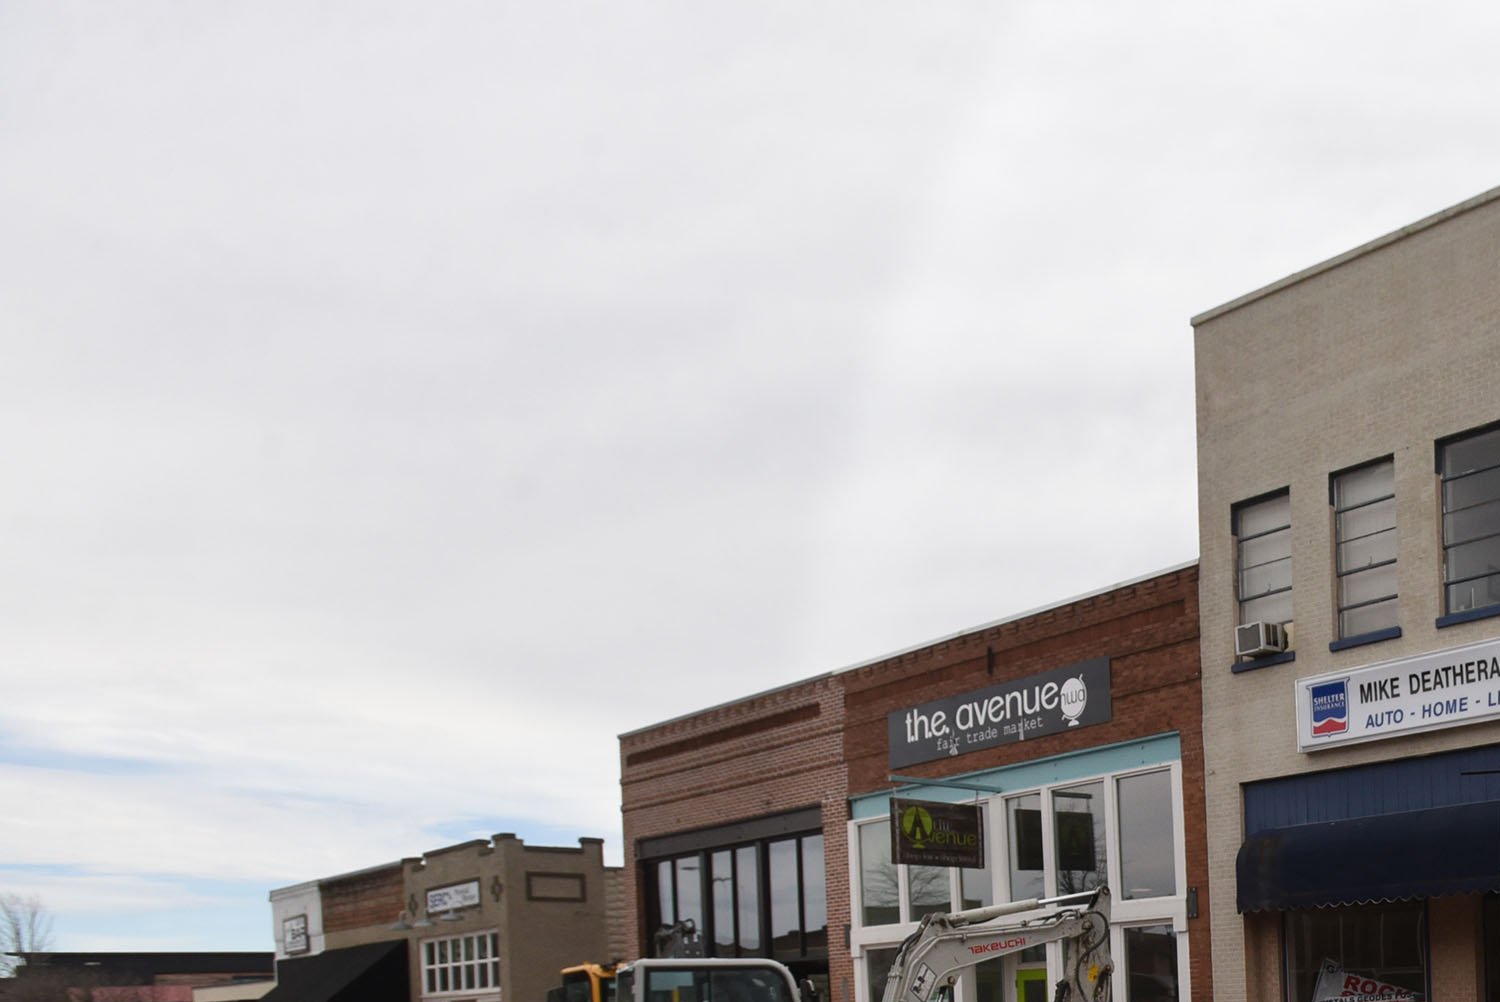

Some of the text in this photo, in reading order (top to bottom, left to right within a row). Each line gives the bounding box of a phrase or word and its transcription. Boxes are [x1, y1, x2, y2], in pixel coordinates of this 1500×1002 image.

[1313, 693, 1345, 706] SHELTER
[1359, 677, 1401, 704] MIKE
[955, 682, 1059, 730] avenue
[1313, 701, 1345, 712] INSURANCE
[1365, 709, 1404, 728] AUTO
[1422, 696, 1469, 719] HOME
[966, 727, 998, 744] trade
[1003, 717, 1044, 736] market
